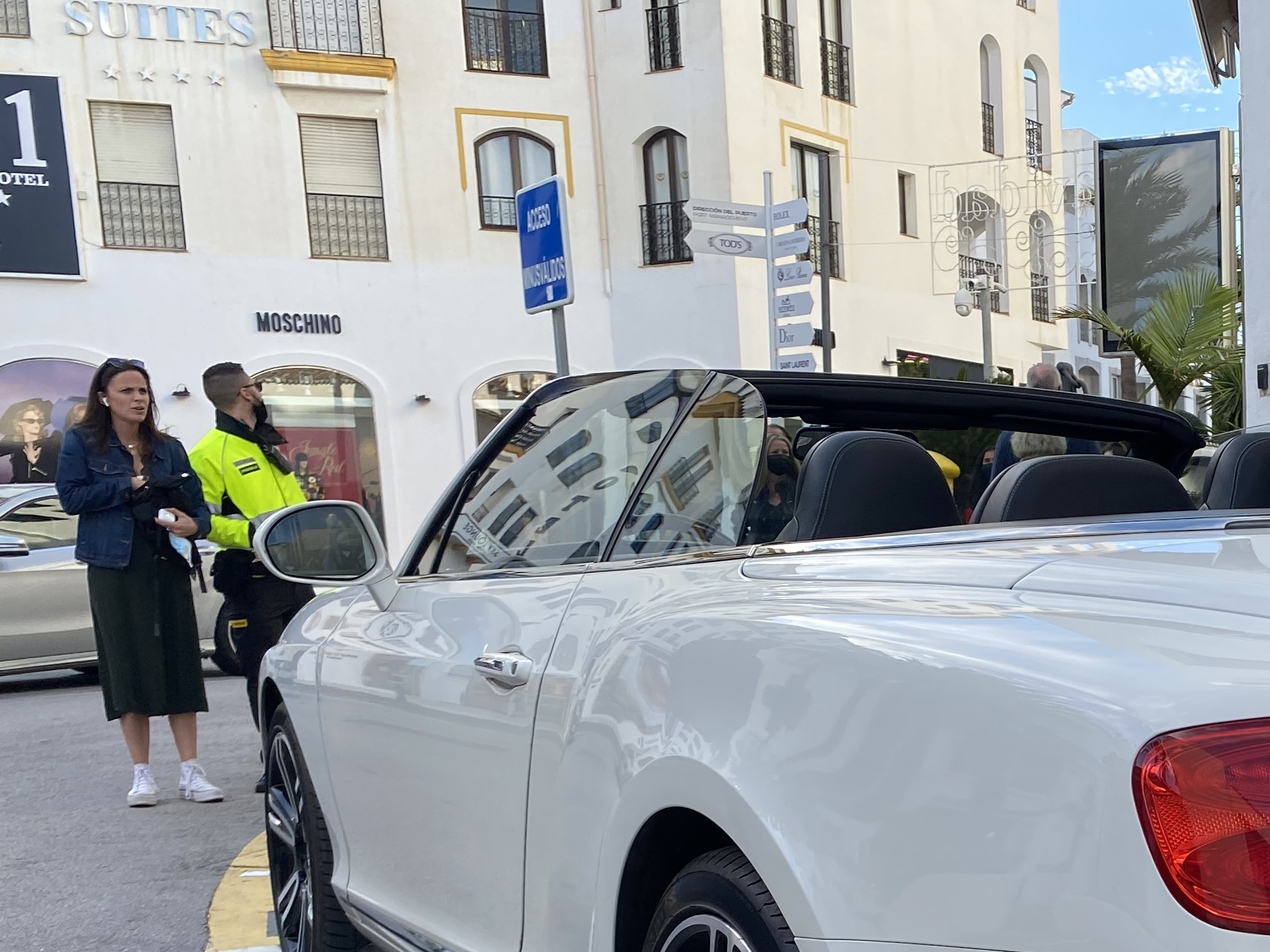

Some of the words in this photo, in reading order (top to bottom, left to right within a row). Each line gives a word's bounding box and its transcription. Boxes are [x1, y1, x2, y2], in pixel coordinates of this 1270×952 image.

[64, 0, 256, 47] SUITES
[4, 90, 47, 167] 1
[527, 204, 551, 232] ACCESO
[255, 311, 342, 335] MOSCHINO
[778, 328, 795, 344] Dior
[780, 361, 791, 370] SAINT
[791, 359, 810, 369] LAURENT
